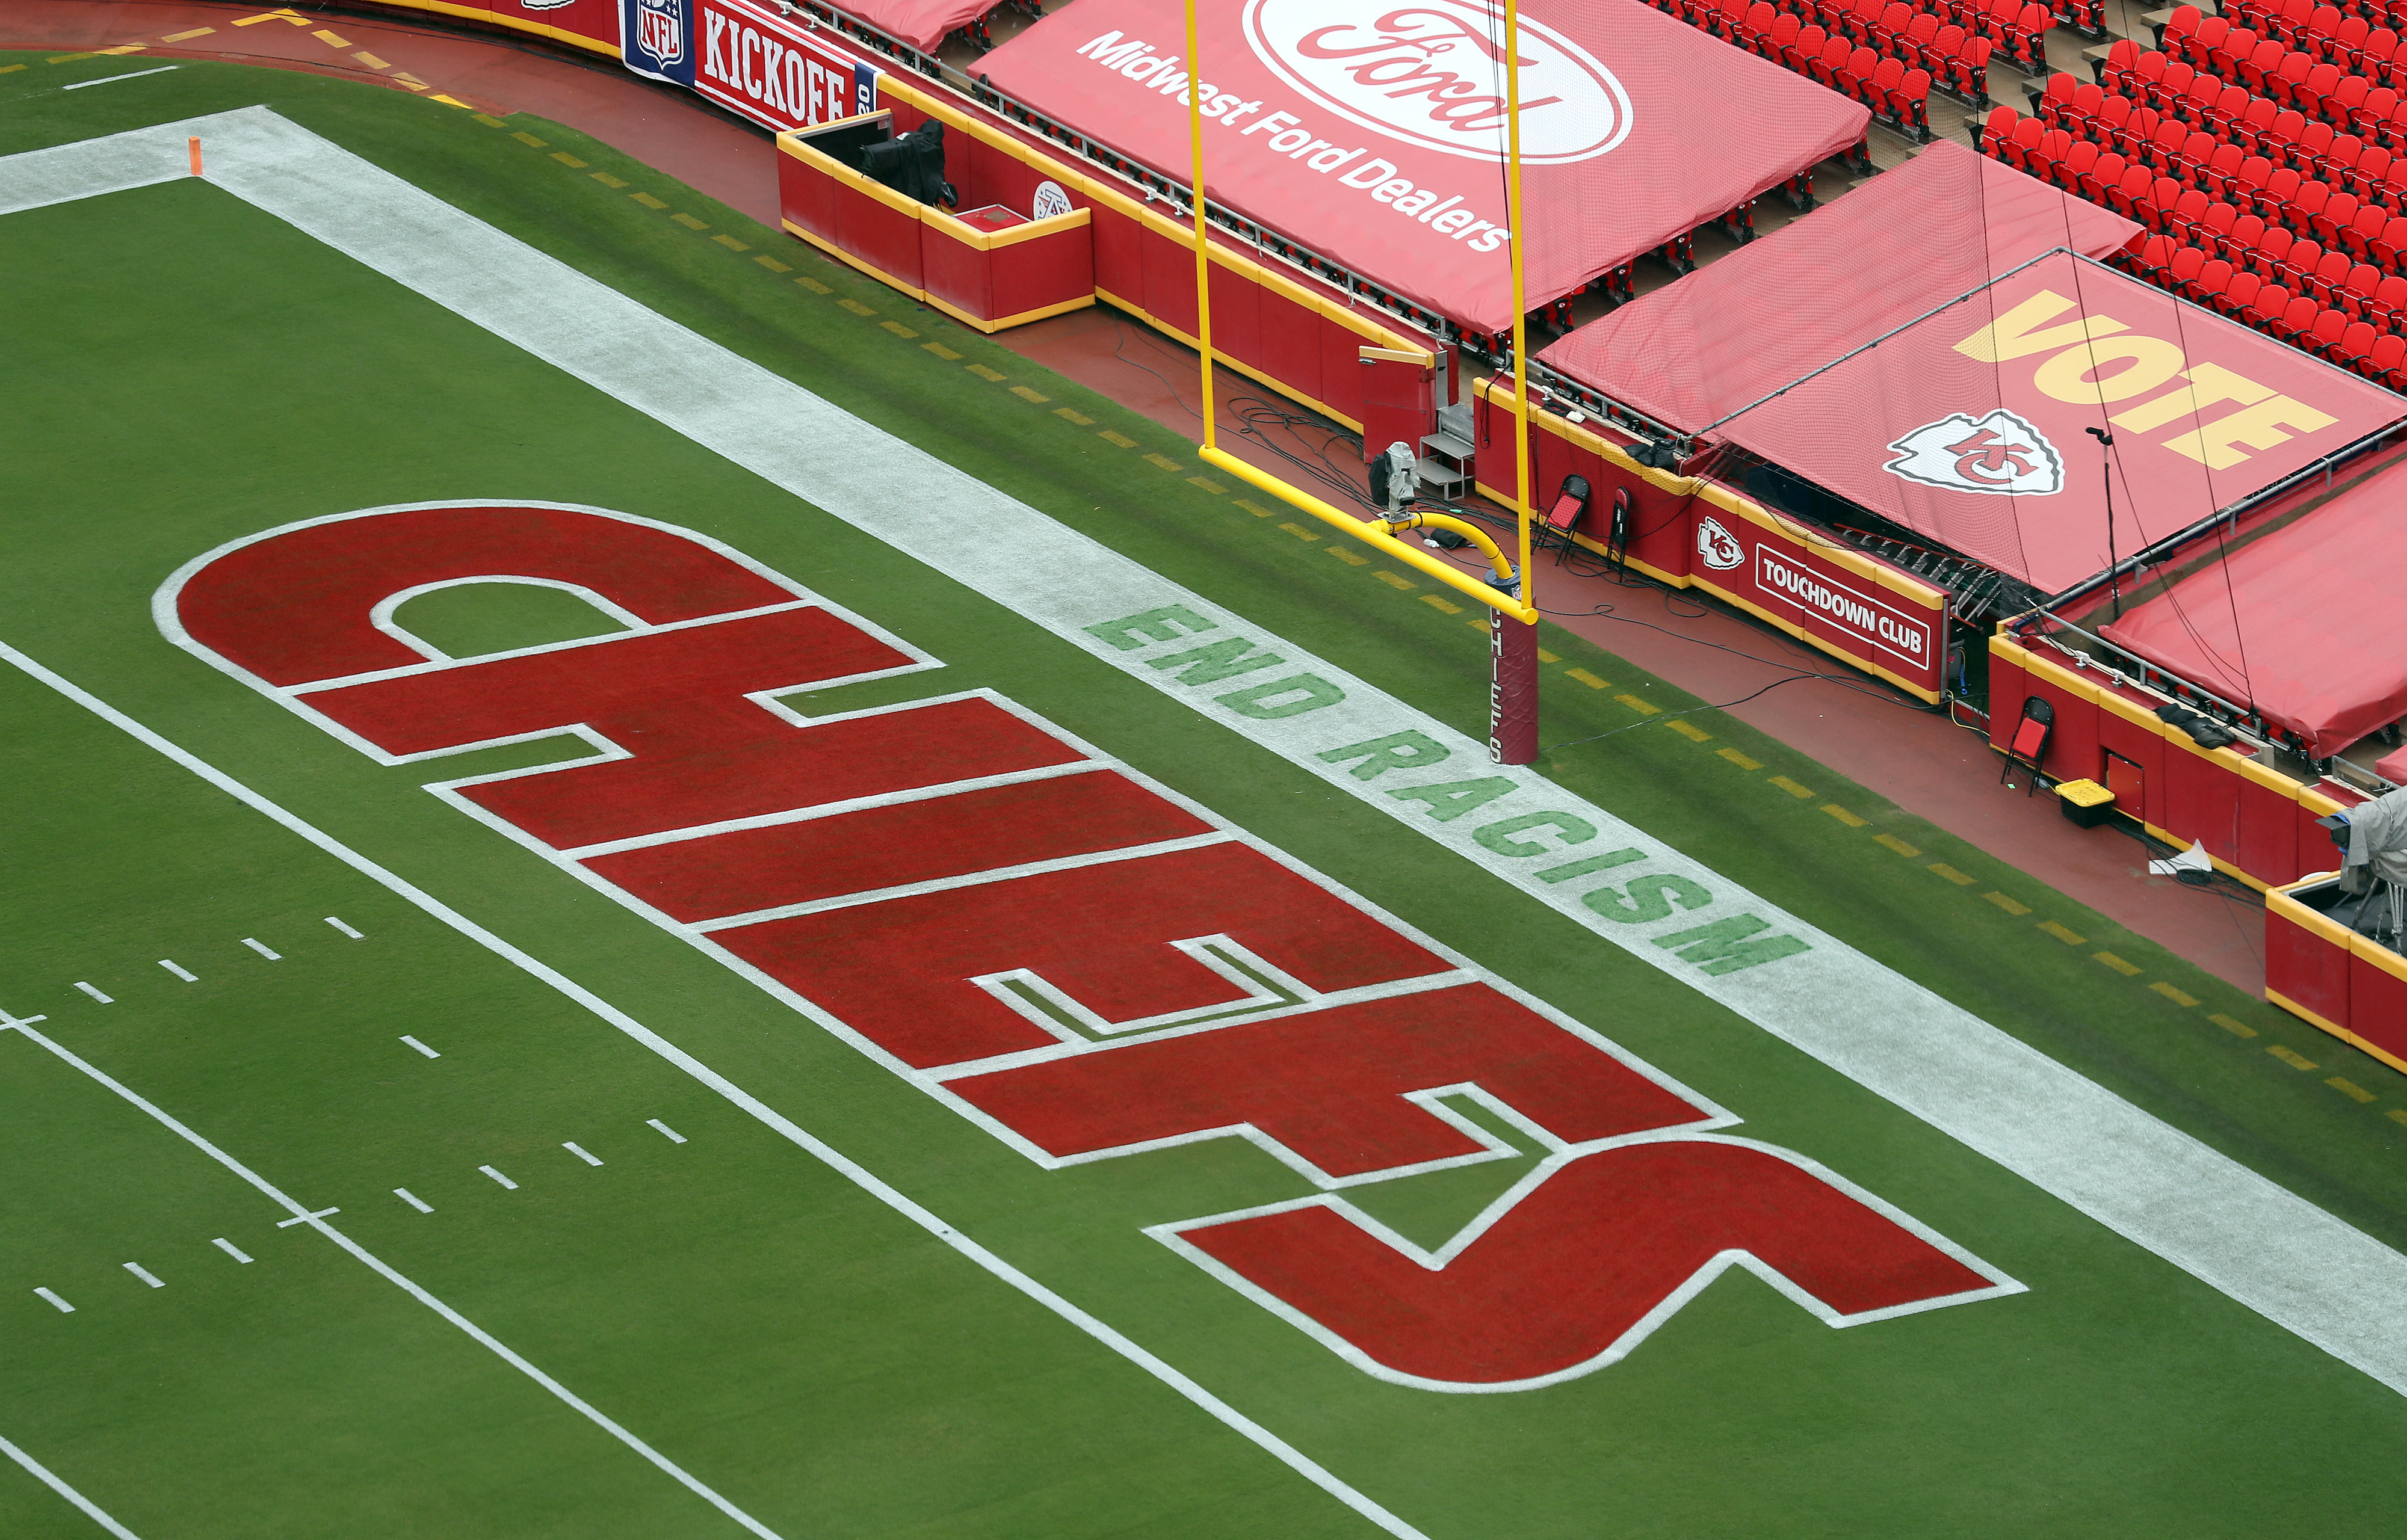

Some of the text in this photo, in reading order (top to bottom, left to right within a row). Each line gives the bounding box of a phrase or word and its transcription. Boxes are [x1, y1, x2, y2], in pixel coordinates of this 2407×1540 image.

[641, 9, 678, 55] NFL
[703, 7, 844, 126] KICKOFF
[1297, 8, 1563, 131] Ford
[1075, 29, 1512, 252] Midwest Ford Dealers
[1951, 289, 2340, 471] VOTE
[1489, 605, 1503, 764] CHIEFS
[1763, 558, 1923, 654] TOUCHDOWN CLUB
[1083, 603, 1811, 977] END RACISM
[153, 498, 2028, 1395] CHIEFS
